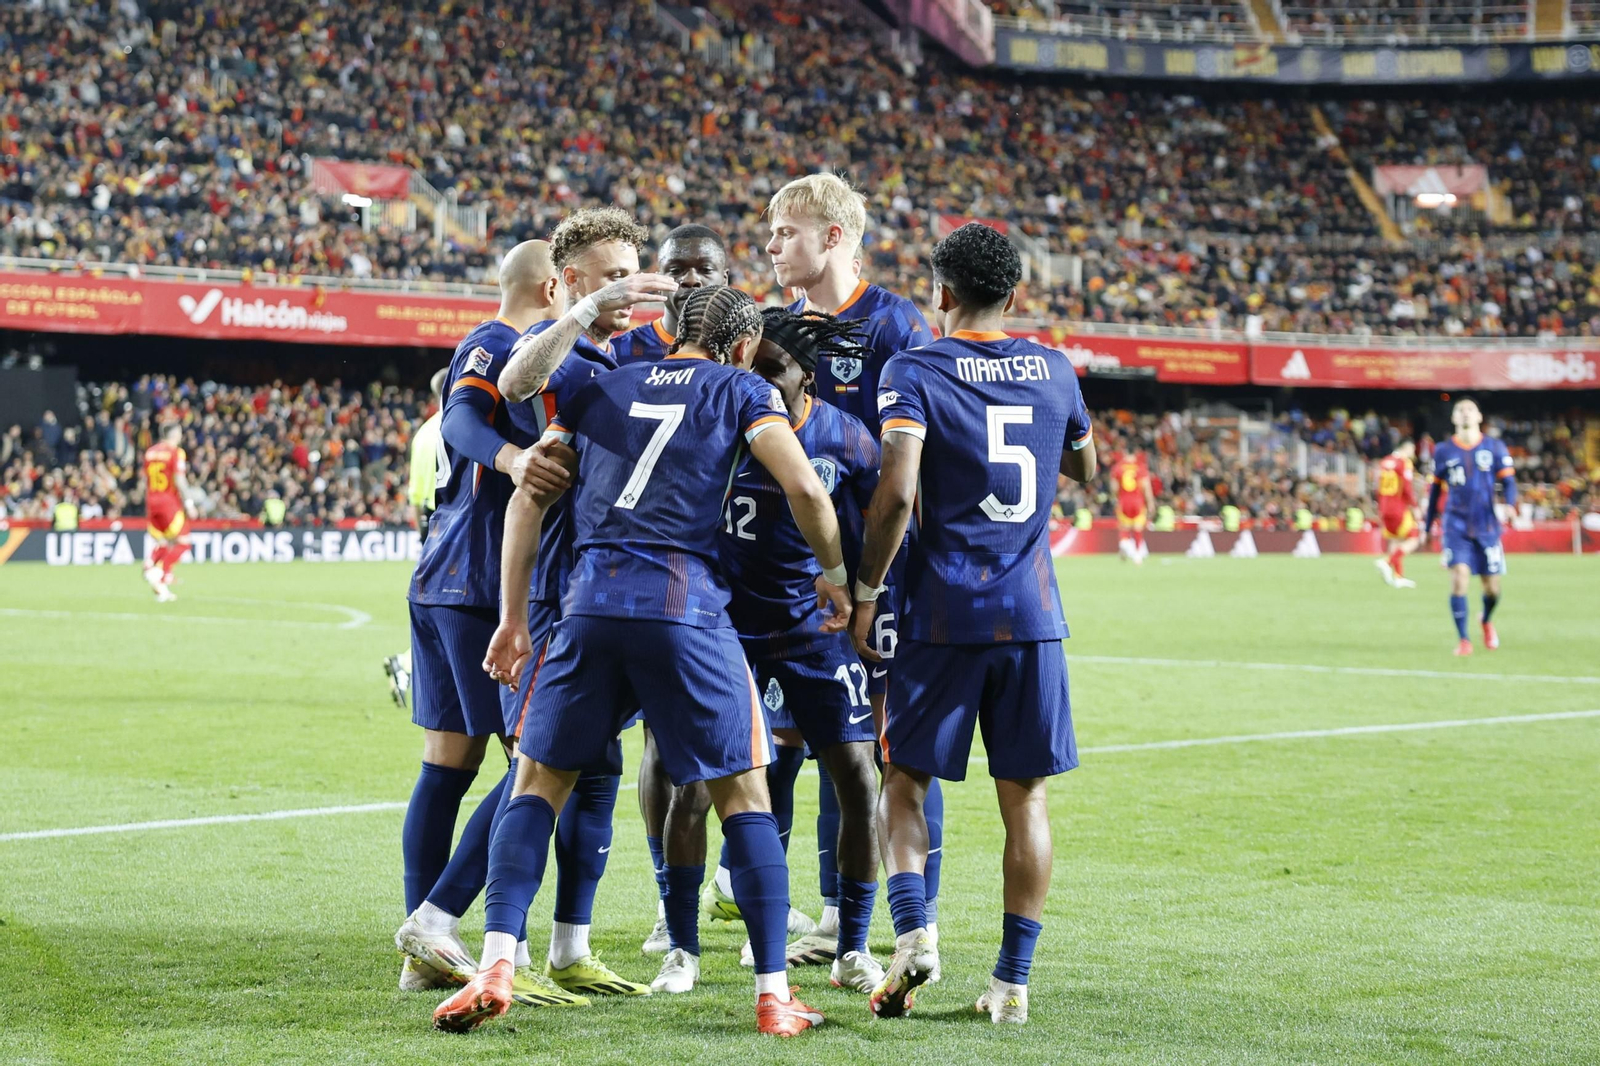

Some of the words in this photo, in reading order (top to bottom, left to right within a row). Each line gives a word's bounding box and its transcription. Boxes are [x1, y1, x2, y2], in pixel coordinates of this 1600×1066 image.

[6, 300, 31, 316] DE
[222, 297, 307, 329] Halcón
[645, 365, 696, 386] XAVI
[956, 355, 1050, 383] MAATSEN
[614, 401, 687, 511] 7
[978, 405, 1037, 524] 5
[724, 495, 758, 541] 12
[45, 532, 136, 565] UEFA
[875, 613, 898, 659] 6
[834, 662, 871, 707] 12
